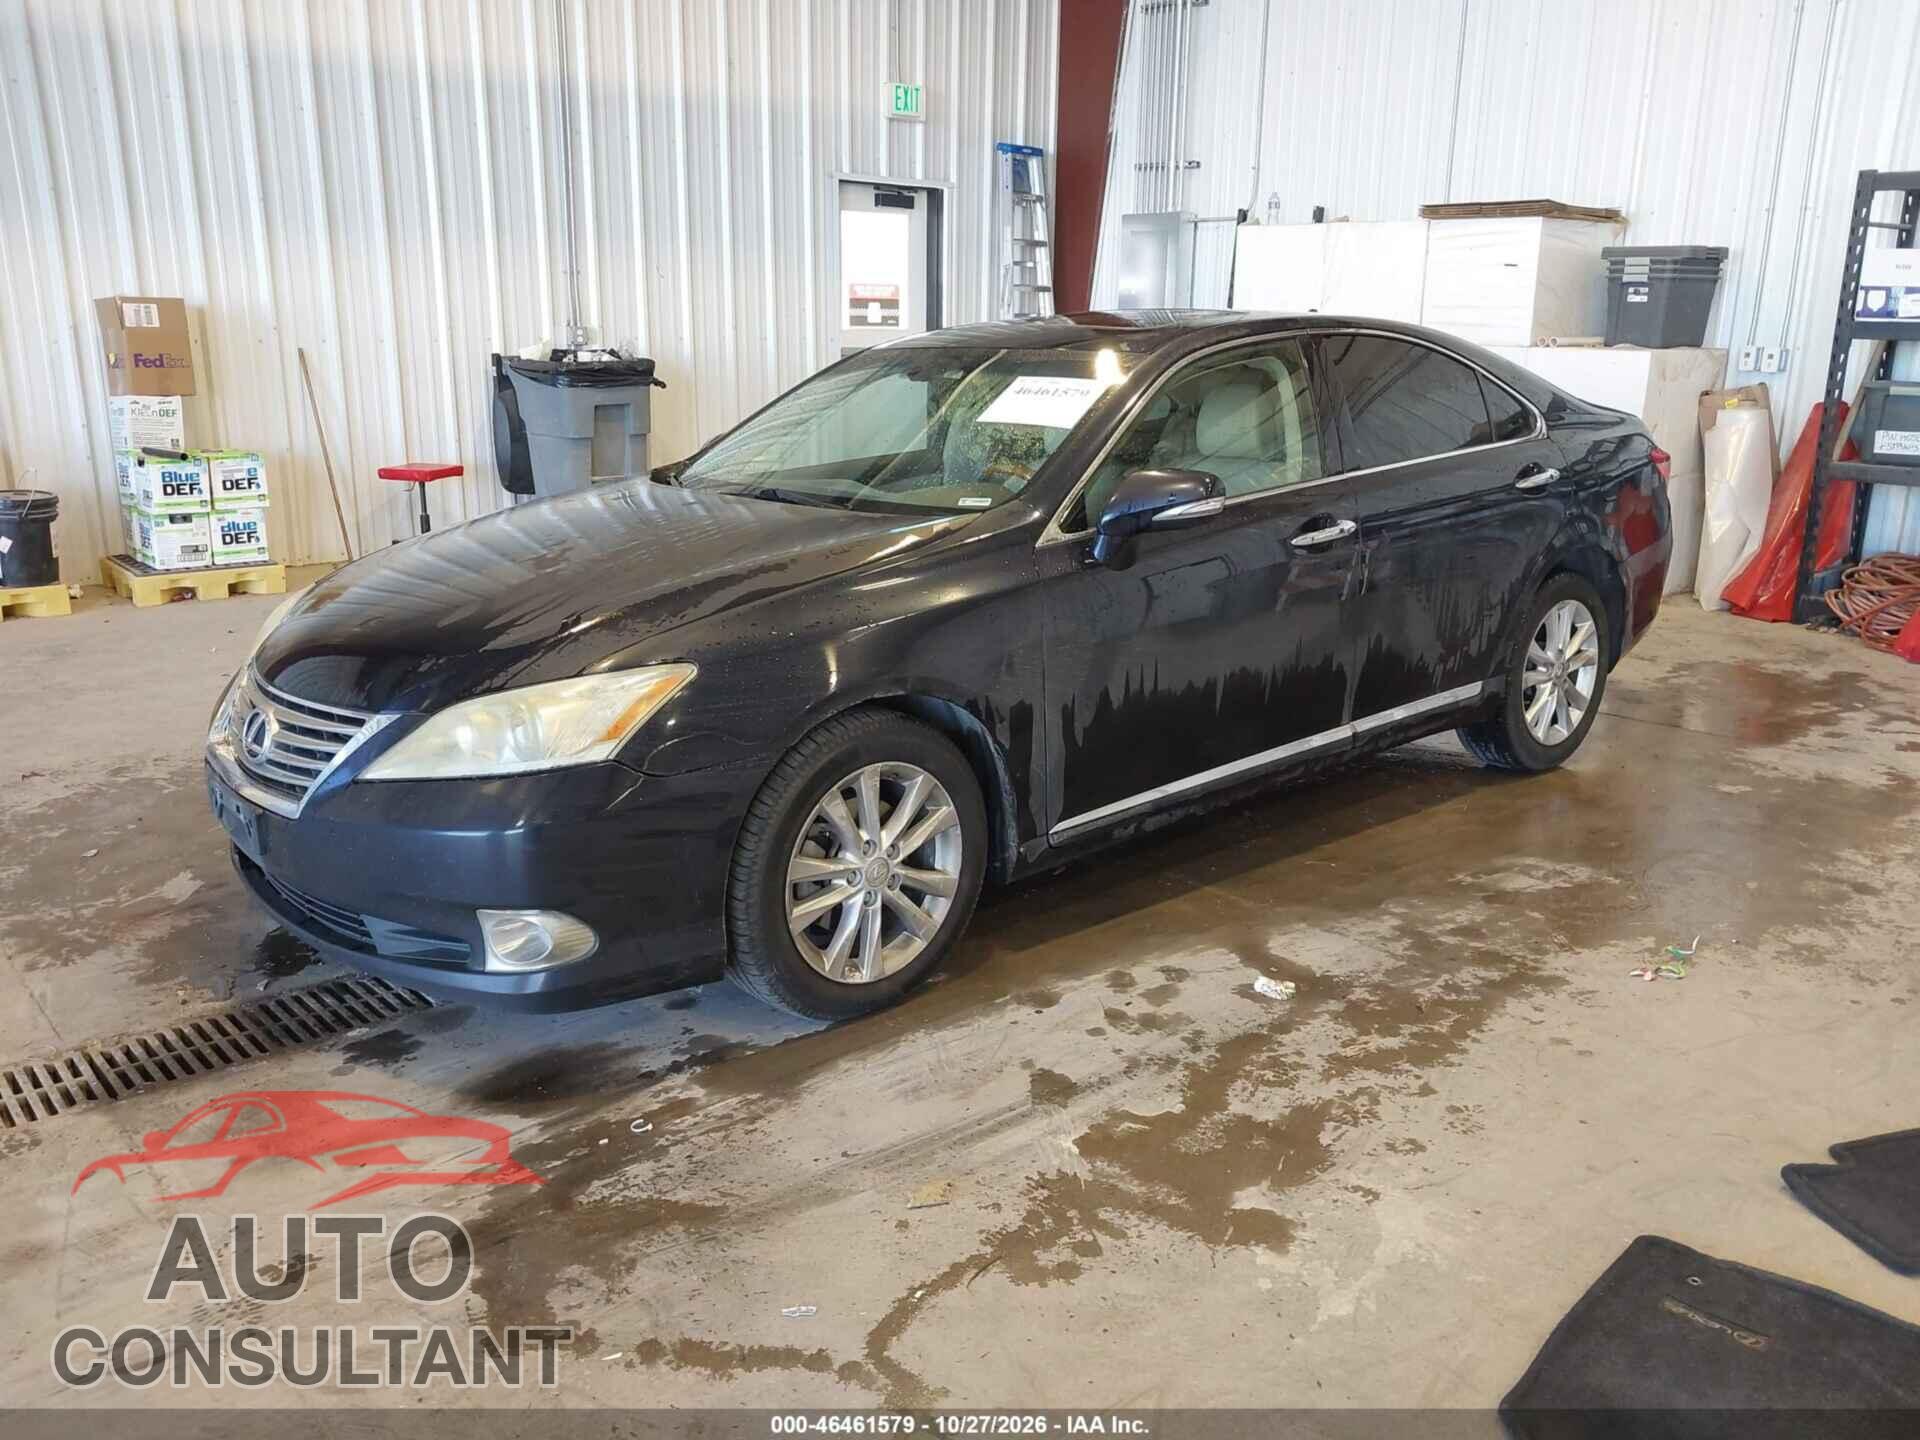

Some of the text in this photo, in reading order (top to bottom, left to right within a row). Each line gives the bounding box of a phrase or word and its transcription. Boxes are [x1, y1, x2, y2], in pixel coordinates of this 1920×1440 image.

[895, 85, 921, 113] EXIT
[161, 471, 200, 483] Blue
[162, 484, 199, 496] DEF
[222, 477, 258, 491] DEF
[222, 532, 258, 545] DEF
